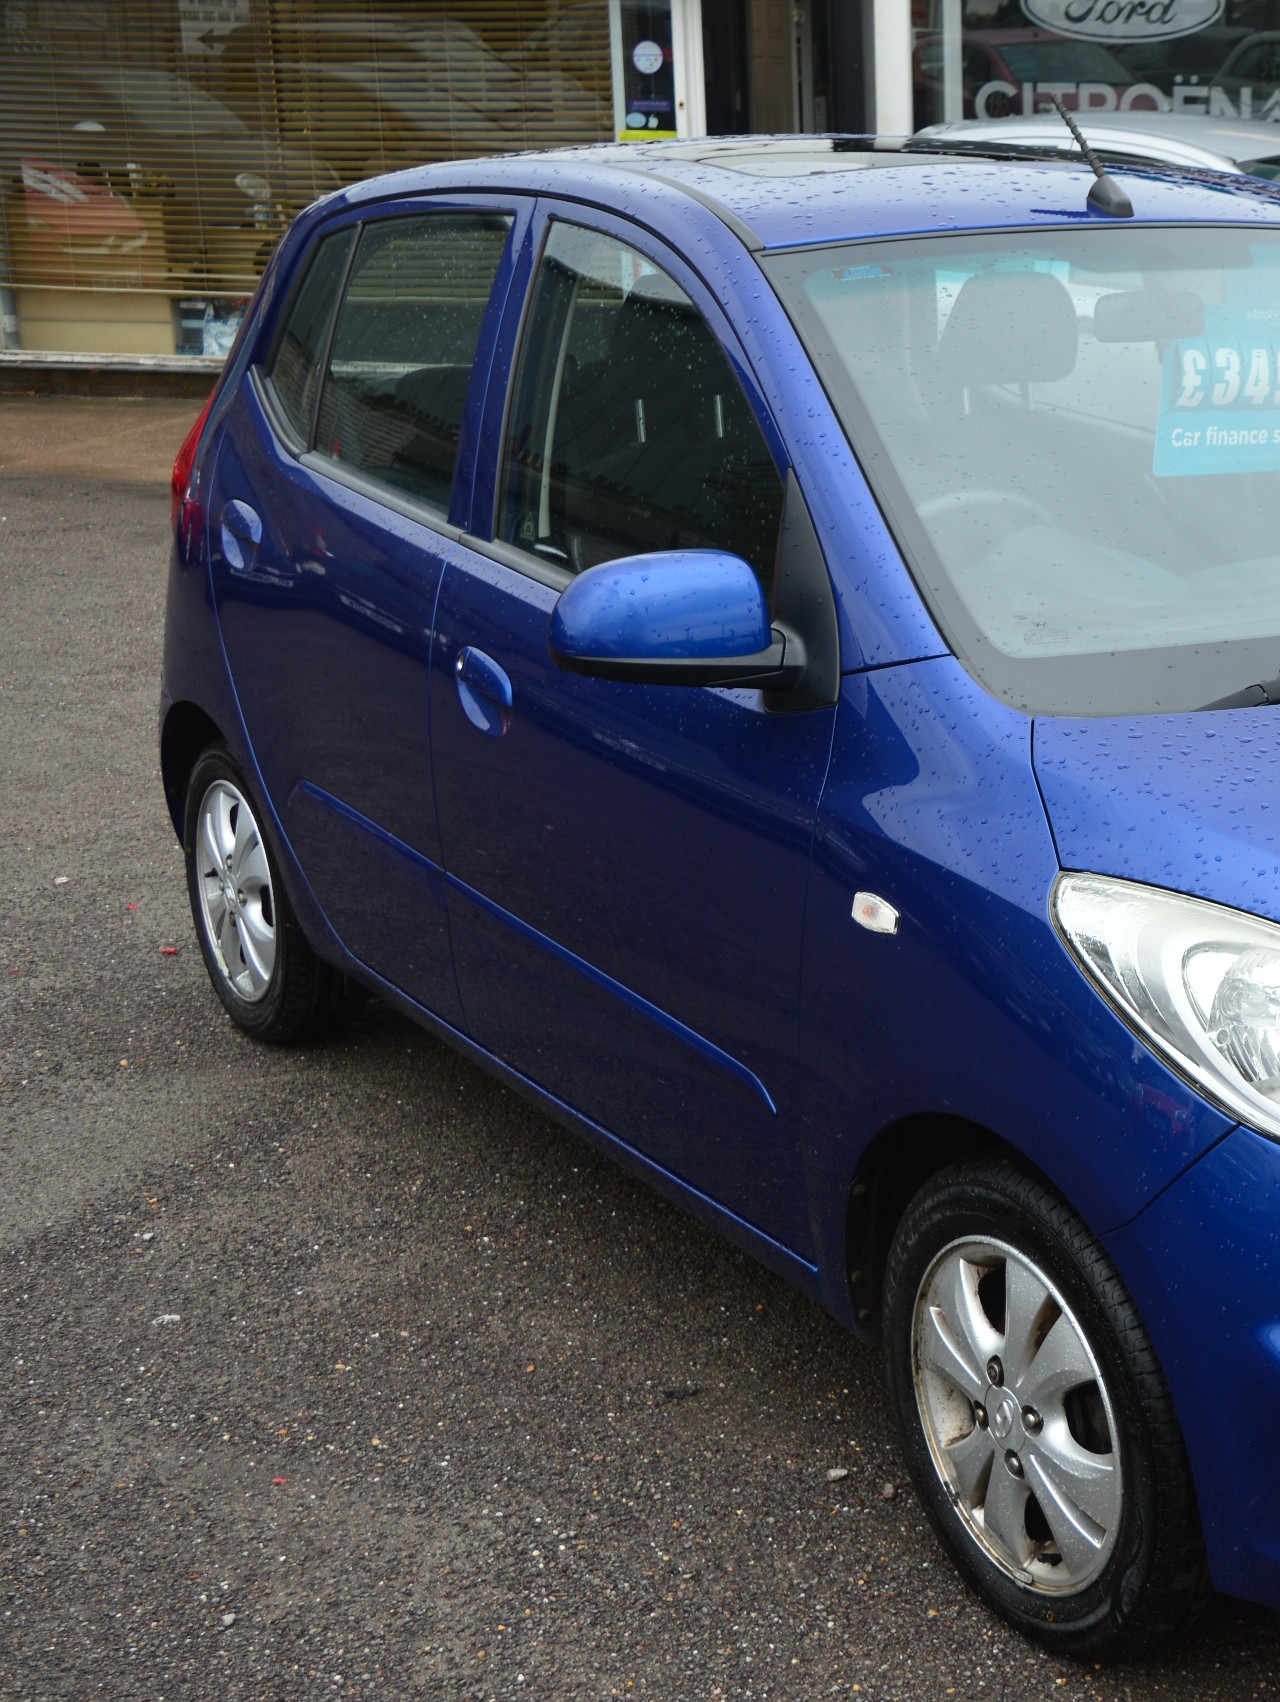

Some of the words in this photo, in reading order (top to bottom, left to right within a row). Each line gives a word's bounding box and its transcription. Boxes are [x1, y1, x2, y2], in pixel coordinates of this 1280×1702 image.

[975, 75, 1253, 119] CITROËN
[1171, 427, 1201, 447] Car
[1205, 425, 1269, 446] finance
